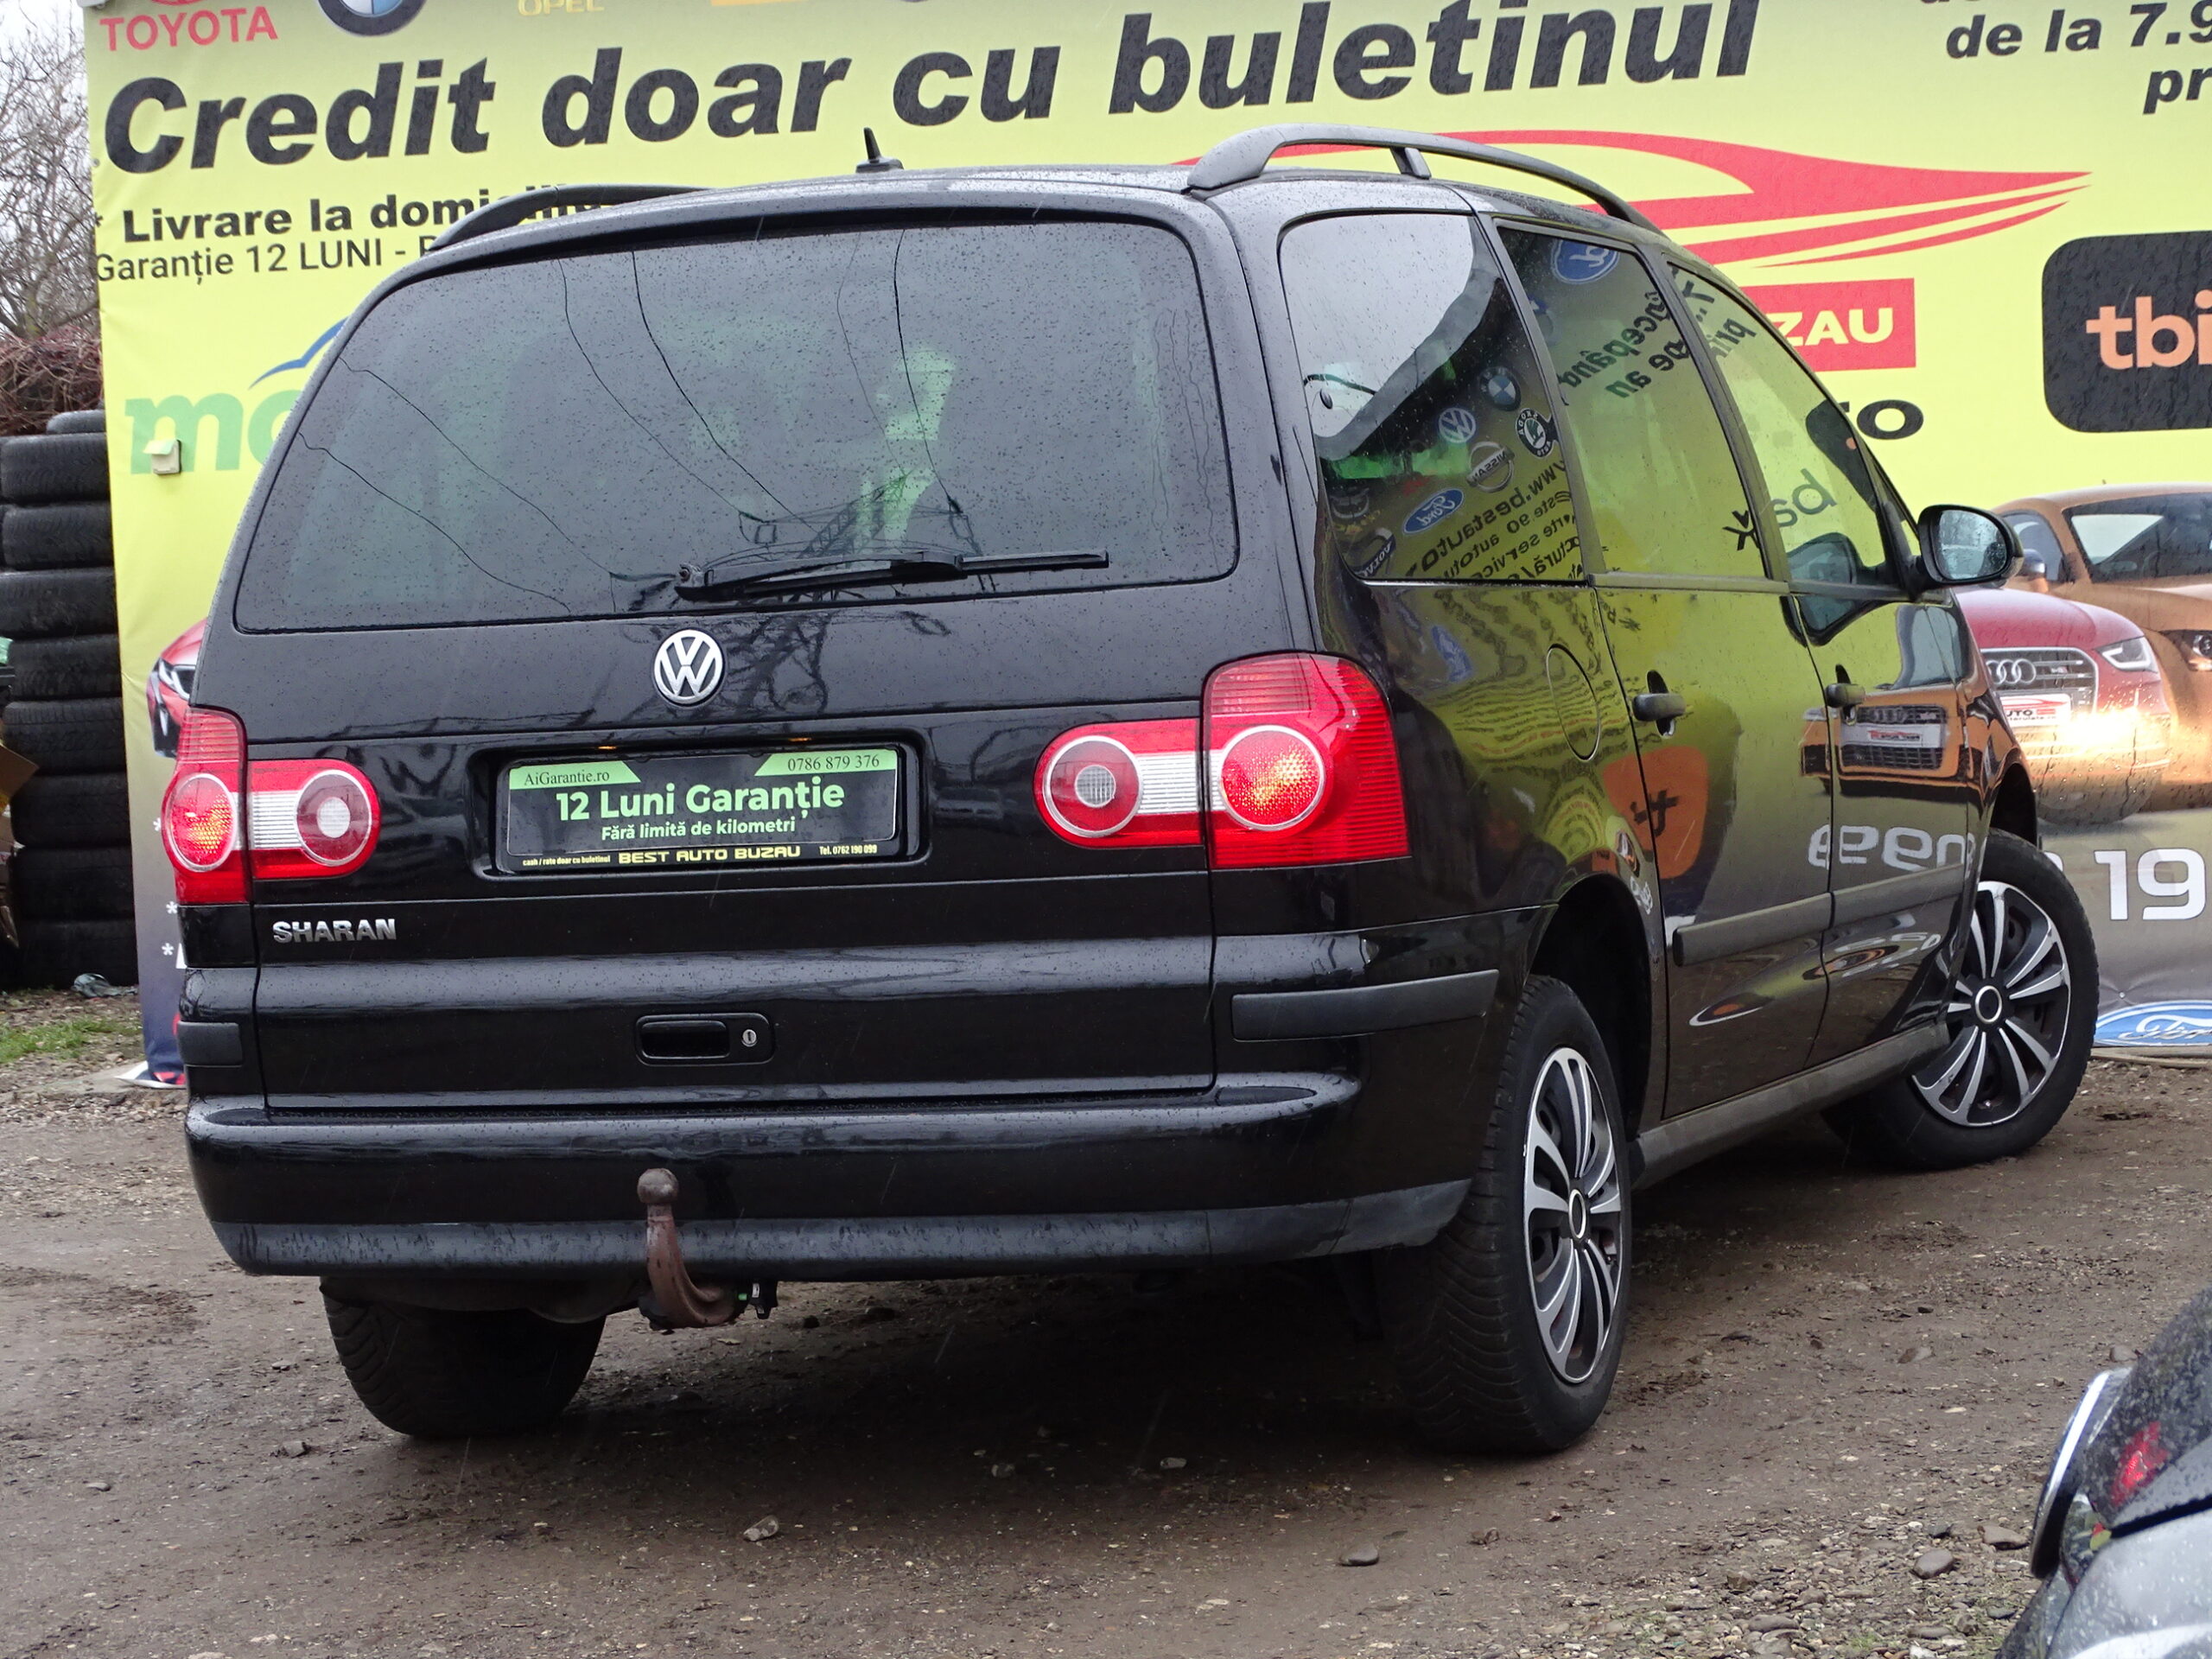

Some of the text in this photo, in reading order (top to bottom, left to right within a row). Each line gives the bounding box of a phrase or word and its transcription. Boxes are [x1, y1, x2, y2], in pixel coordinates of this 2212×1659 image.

[99, 6, 278, 51] TOYOTA
[518, 0, 606, 16] OPEL
[1947, 15, 2022, 59] de
[2044, 9, 2101, 52] la
[105, 0, 1760, 174] Credit doar cu buletinul
[123, 208, 292, 243] Livrare
[310, 199, 353, 232] la
[96, 247, 234, 285] Garanție
[246, 243, 288, 273] 12
[300, 238, 382, 271] LUNI
[2086, 289, 2212, 370] tbi
[524, 769, 610, 787] AiGarantie.ro
[787, 754, 880, 772] 0786 879 376
[556, 775, 845, 822] 12 Luni Garanție
[601, 817, 796, 841] Fără limită de kilometri
[819, 846, 832, 855] Tel.
[833, 845, 849, 855] 0762
[619, 845, 801, 864] BEST AUTO BUZAU
[2094, 848, 2208, 921] 19
[273, 918, 397, 944] SHARAN
